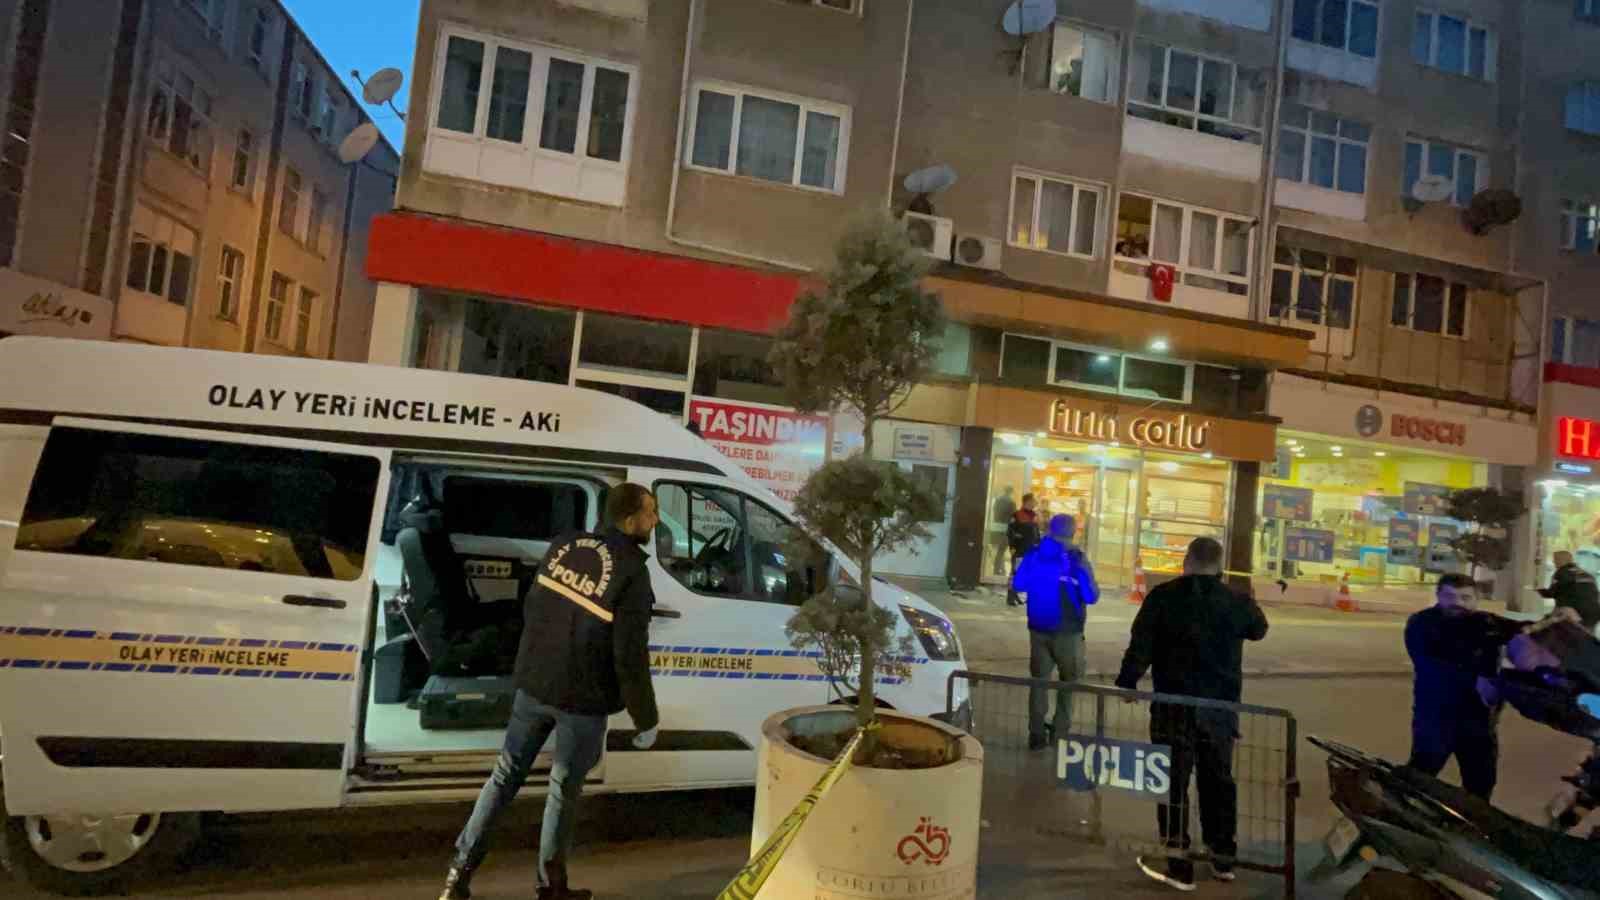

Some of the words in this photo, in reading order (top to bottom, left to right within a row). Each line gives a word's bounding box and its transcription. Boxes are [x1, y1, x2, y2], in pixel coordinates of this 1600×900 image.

[208, 385, 286, 411] OLAY
[1390, 413, 1467, 447] BOSCH
[1564, 417, 1600, 458] H
[119, 645, 164, 661] OLAY
